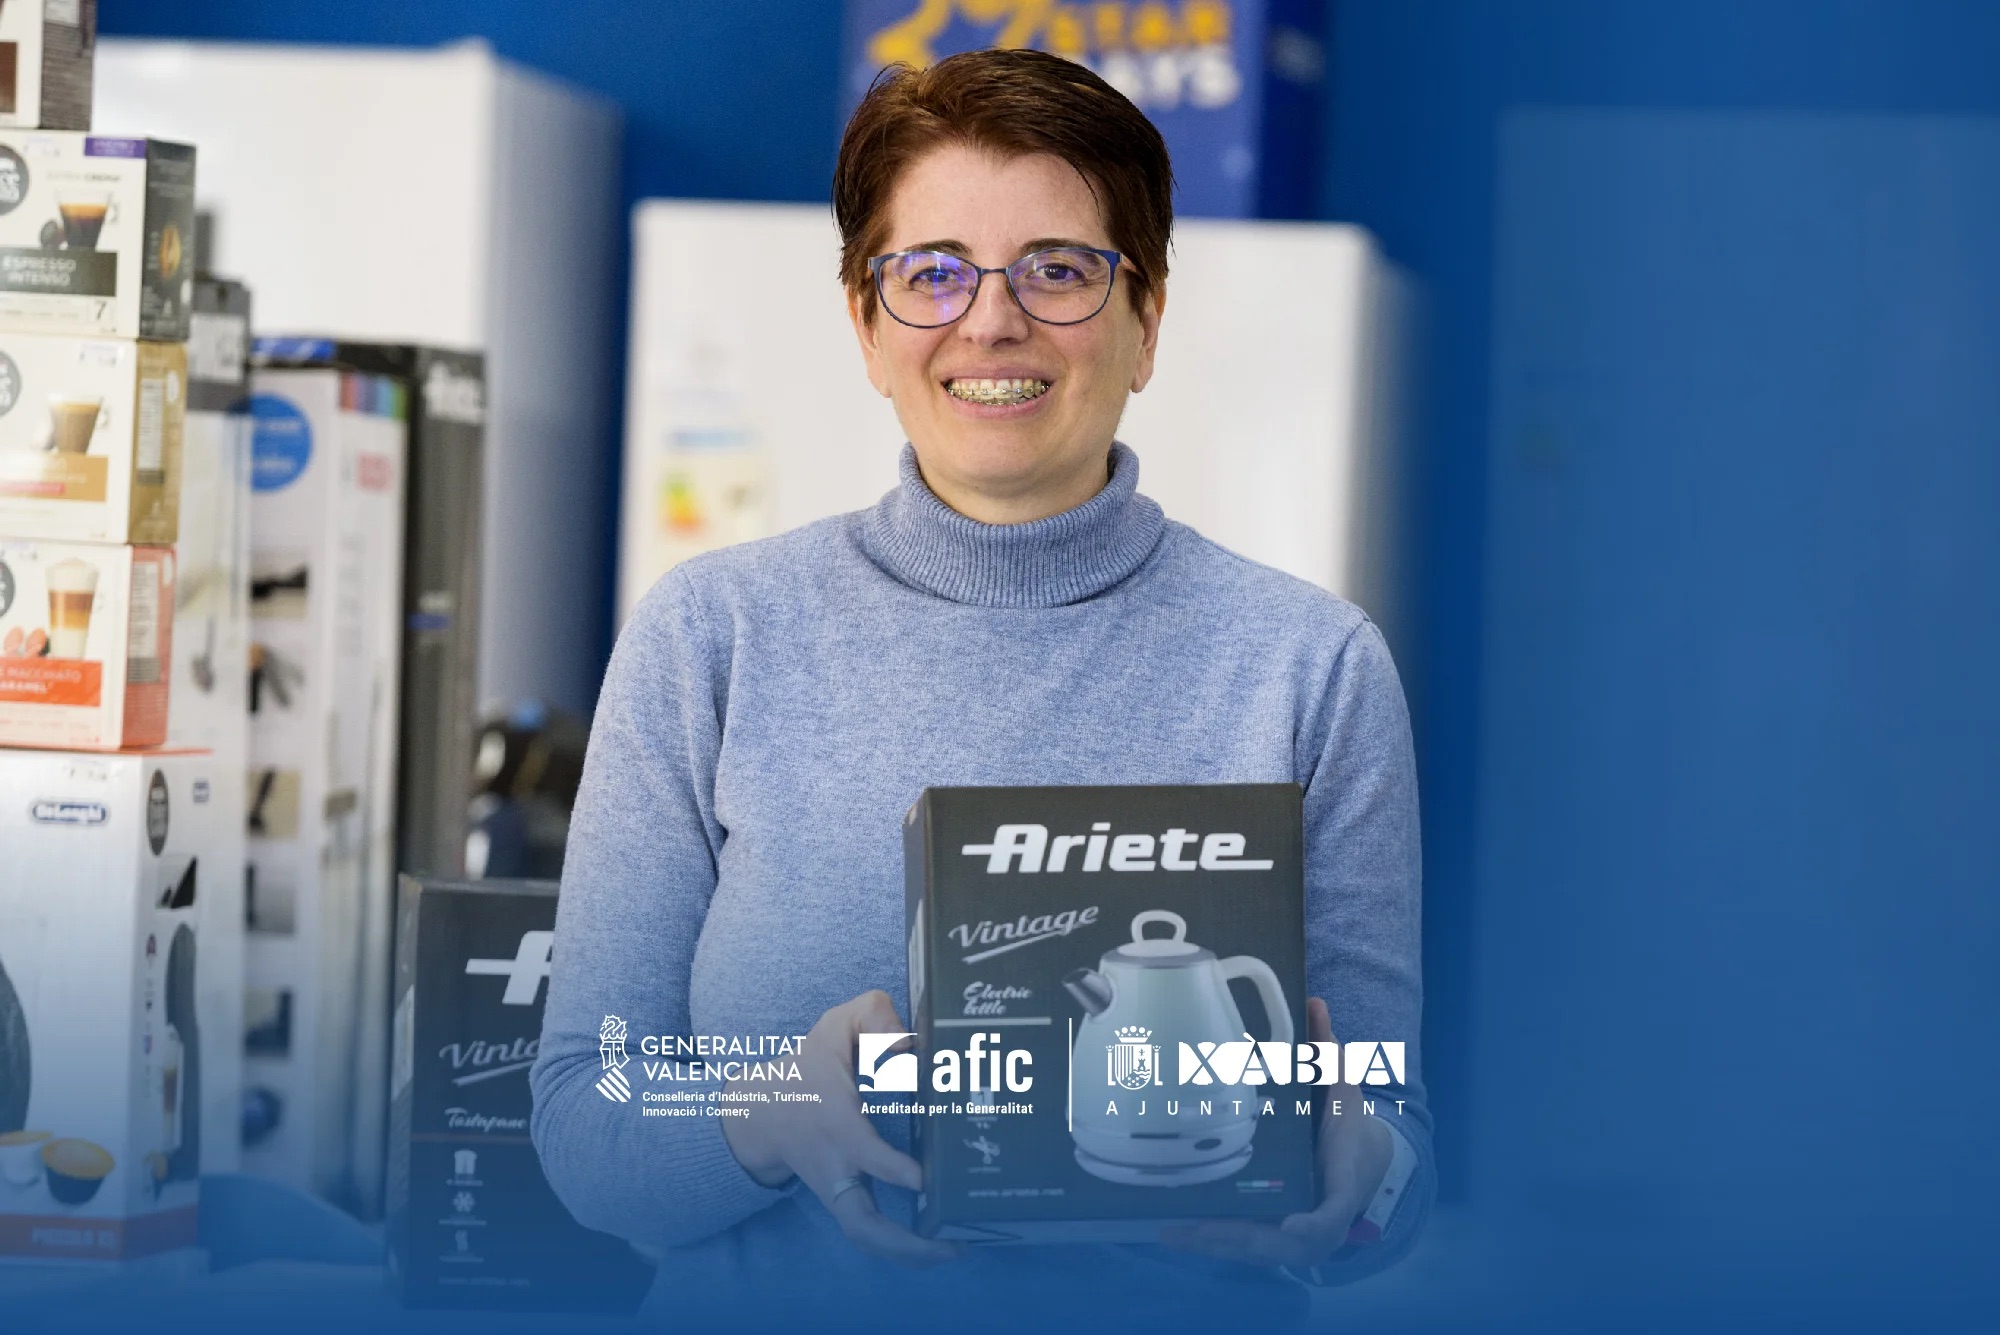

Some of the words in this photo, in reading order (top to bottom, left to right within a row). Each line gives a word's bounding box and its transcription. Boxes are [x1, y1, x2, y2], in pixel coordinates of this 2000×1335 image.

[1060, 46, 1241, 110] AYS
[5, 256, 77, 272] ESPRESSO
[0, 679, 49, 695] ARAMEL
[961, 822, 1274, 874] Ariete
[948, 905, 1099, 949] Vintage
[963, 981, 1033, 1000] Electric
[439, 1037, 540, 1069] Vinta
